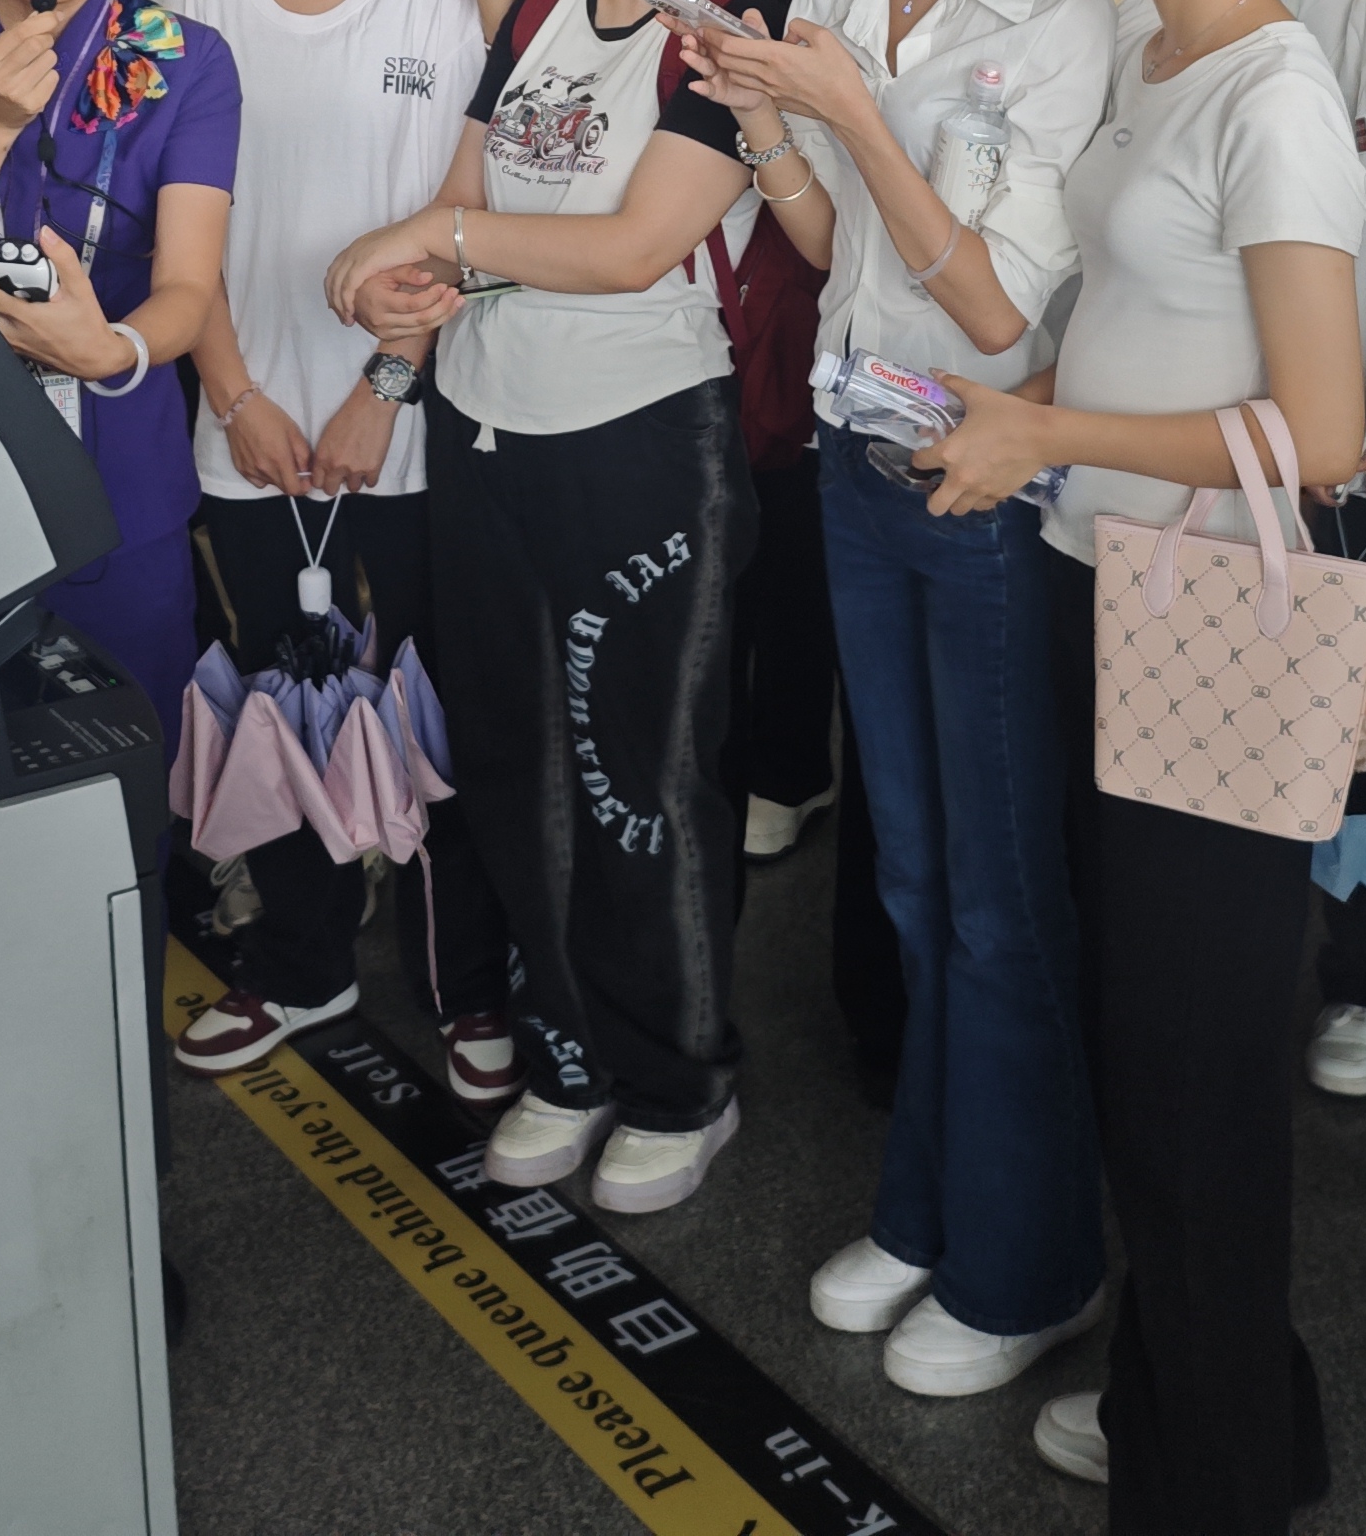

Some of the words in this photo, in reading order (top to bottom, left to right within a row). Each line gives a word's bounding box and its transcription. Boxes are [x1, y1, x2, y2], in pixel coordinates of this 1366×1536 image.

[328, 1042, 421, 1105] Self
[302, 1119, 363, 1167] the
[337, 1160, 467, 1275] behind
[453, 1267, 575, 1370] queue
[557, 1371, 697, 1501] Please
